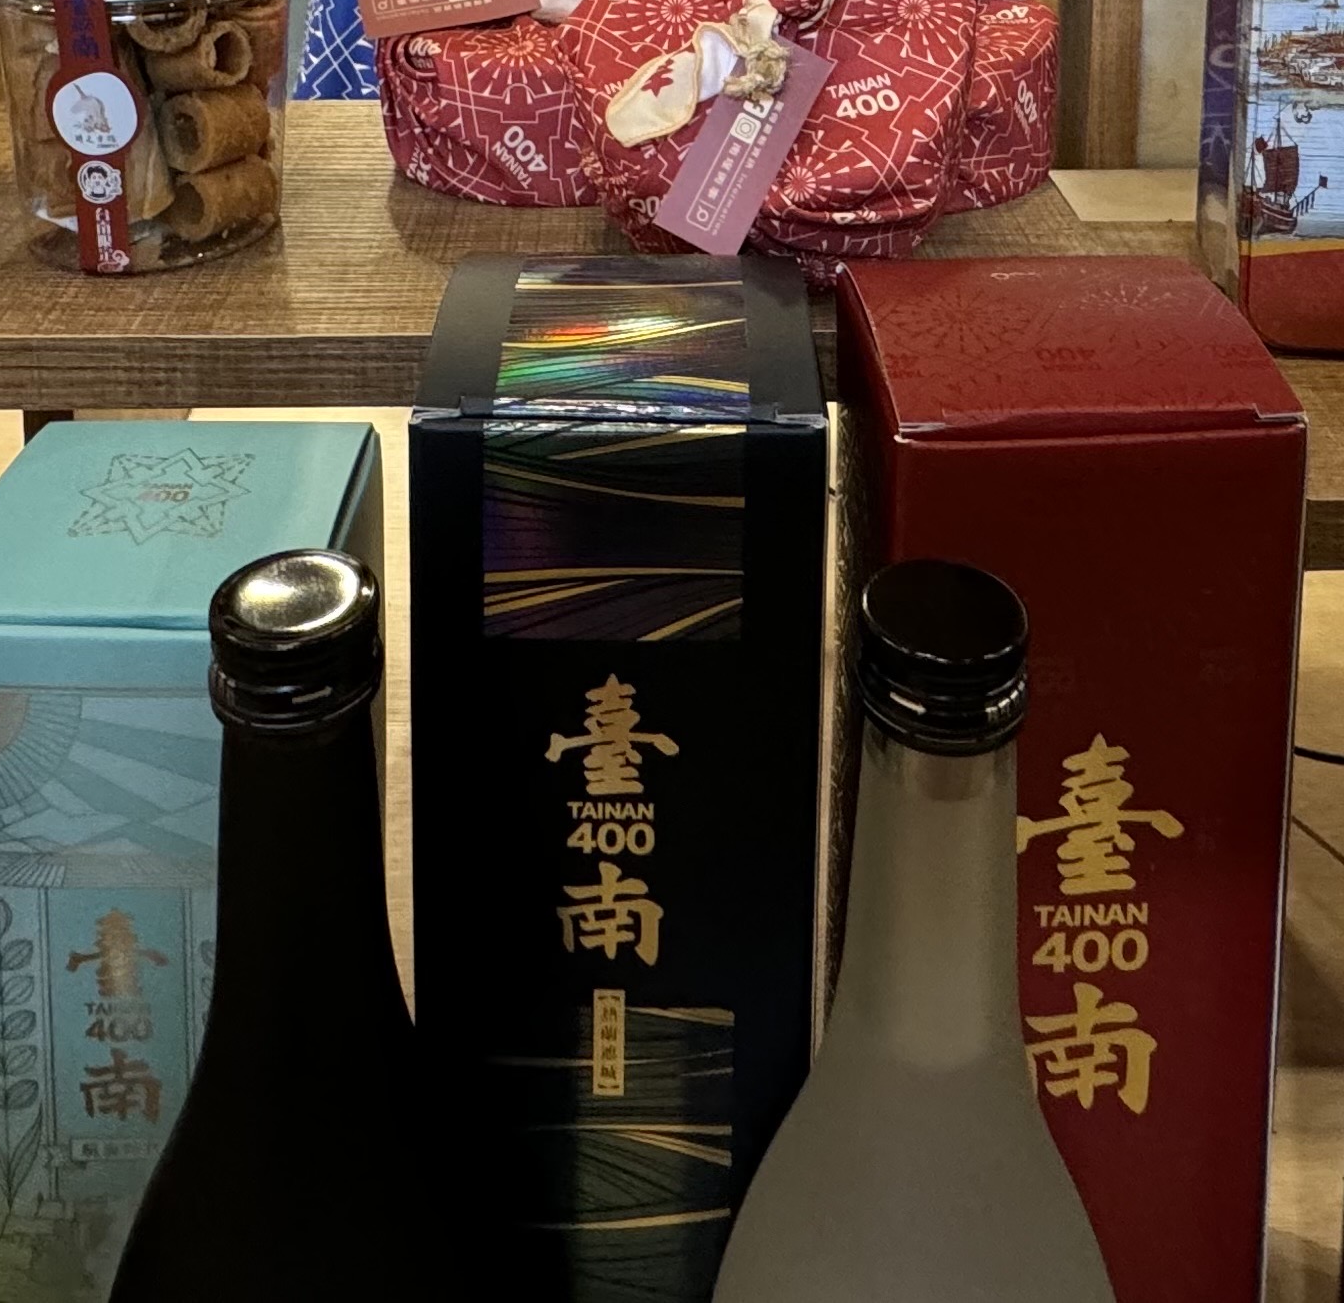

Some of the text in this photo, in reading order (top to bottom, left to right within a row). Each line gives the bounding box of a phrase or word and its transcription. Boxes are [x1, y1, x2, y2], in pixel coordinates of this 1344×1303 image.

[825, 73, 892, 99] TAINAN
[836, 89, 901, 119] 400
[492, 140, 533, 189] TAINAN
[503, 126, 548, 173] 400
[544, 673, 680, 796] 臺
[566, 801, 656, 821] TAINAN
[1016, 732, 1184, 896] 臺
[565, 822, 656, 856] 400
[556, 862, 664, 966] 南
[1034, 901, 1149, 927] TAINAN
[1032, 927, 1149, 973] 400
[85, 1000, 152, 1017] TAINAN
[85, 1015, 155, 1044] 400
[1025, 982, 1158, 1115] 南
[79, 1051, 164, 1125] 南
